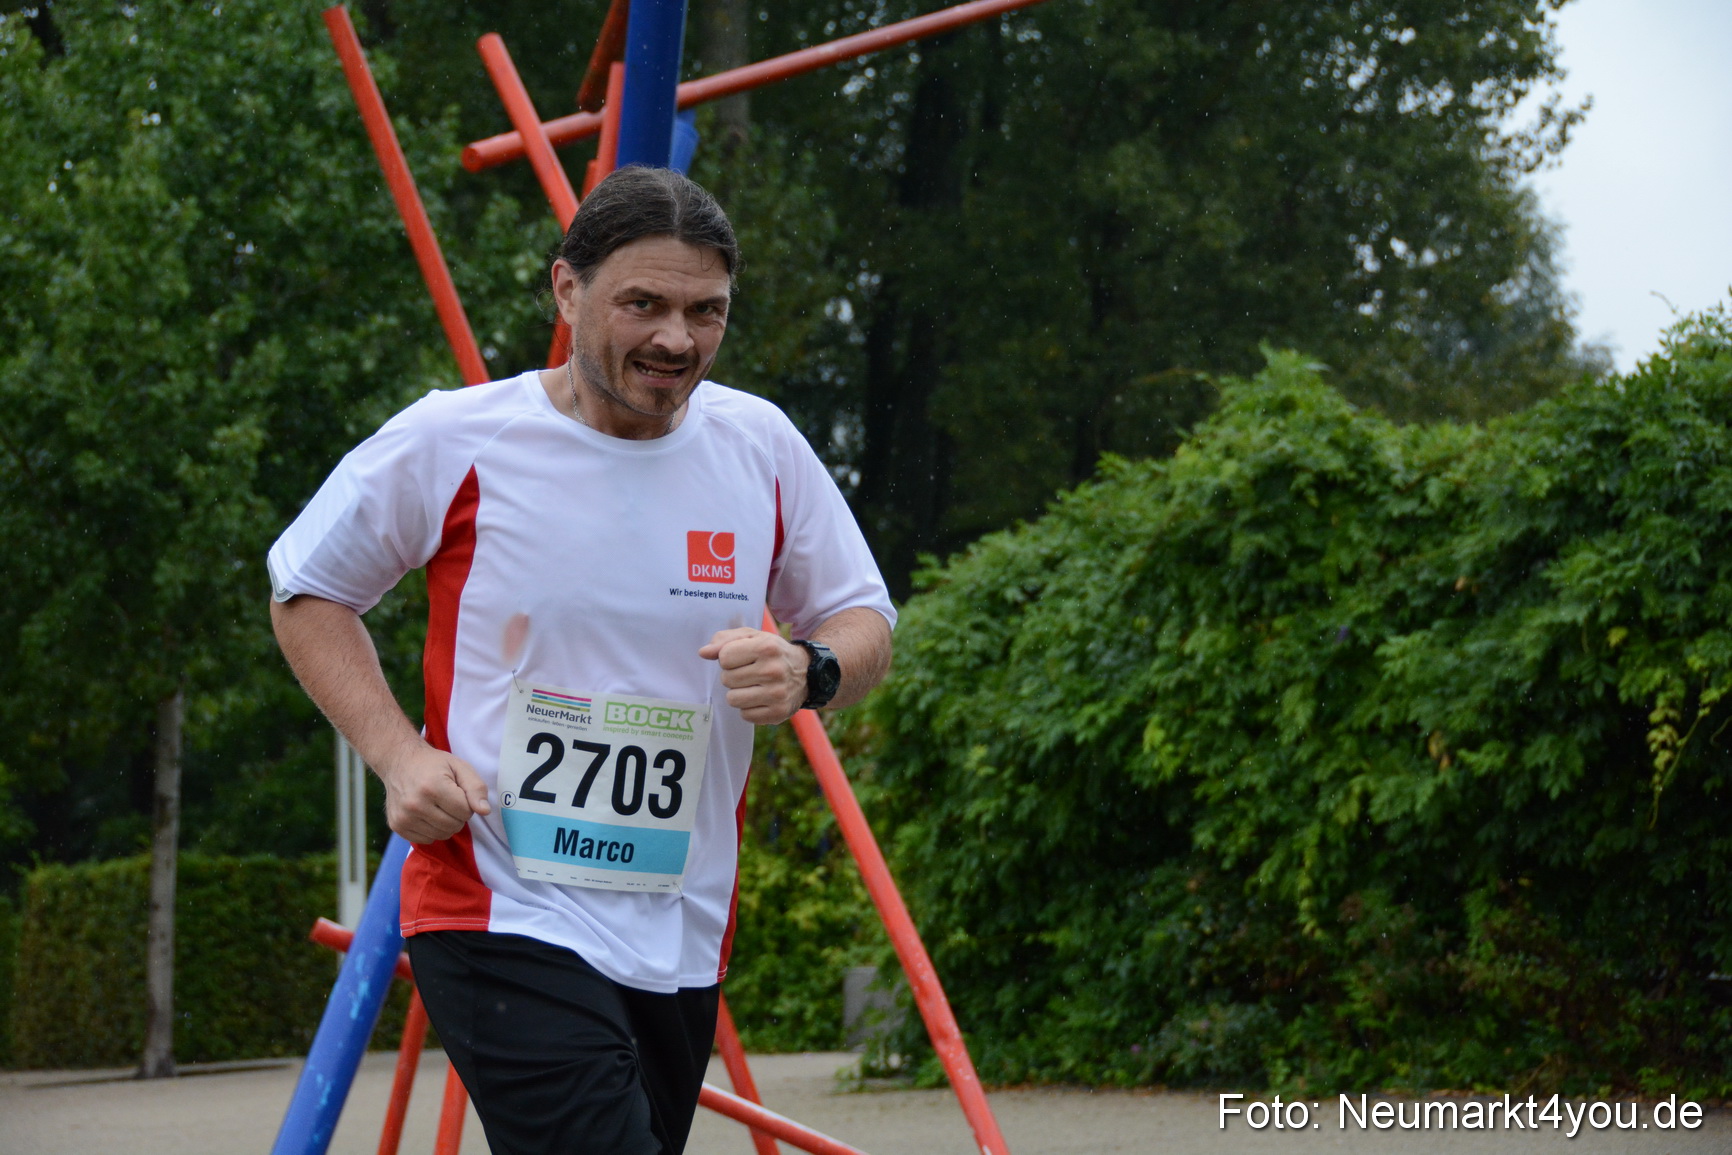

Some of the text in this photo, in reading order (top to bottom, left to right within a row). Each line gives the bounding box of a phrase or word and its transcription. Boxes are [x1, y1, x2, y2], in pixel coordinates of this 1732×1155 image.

[692, 564, 732, 579] DKMS
[669, 588, 749, 601] Wir besiegen Blutkrebs.
[526, 704, 592, 725] NeuerMarkt
[604, 701, 696, 732] BOCK
[603, 725, 694, 741] inspired by smart concepts
[519, 732, 686, 819] 2703
[553, 827, 635, 863] Marco
